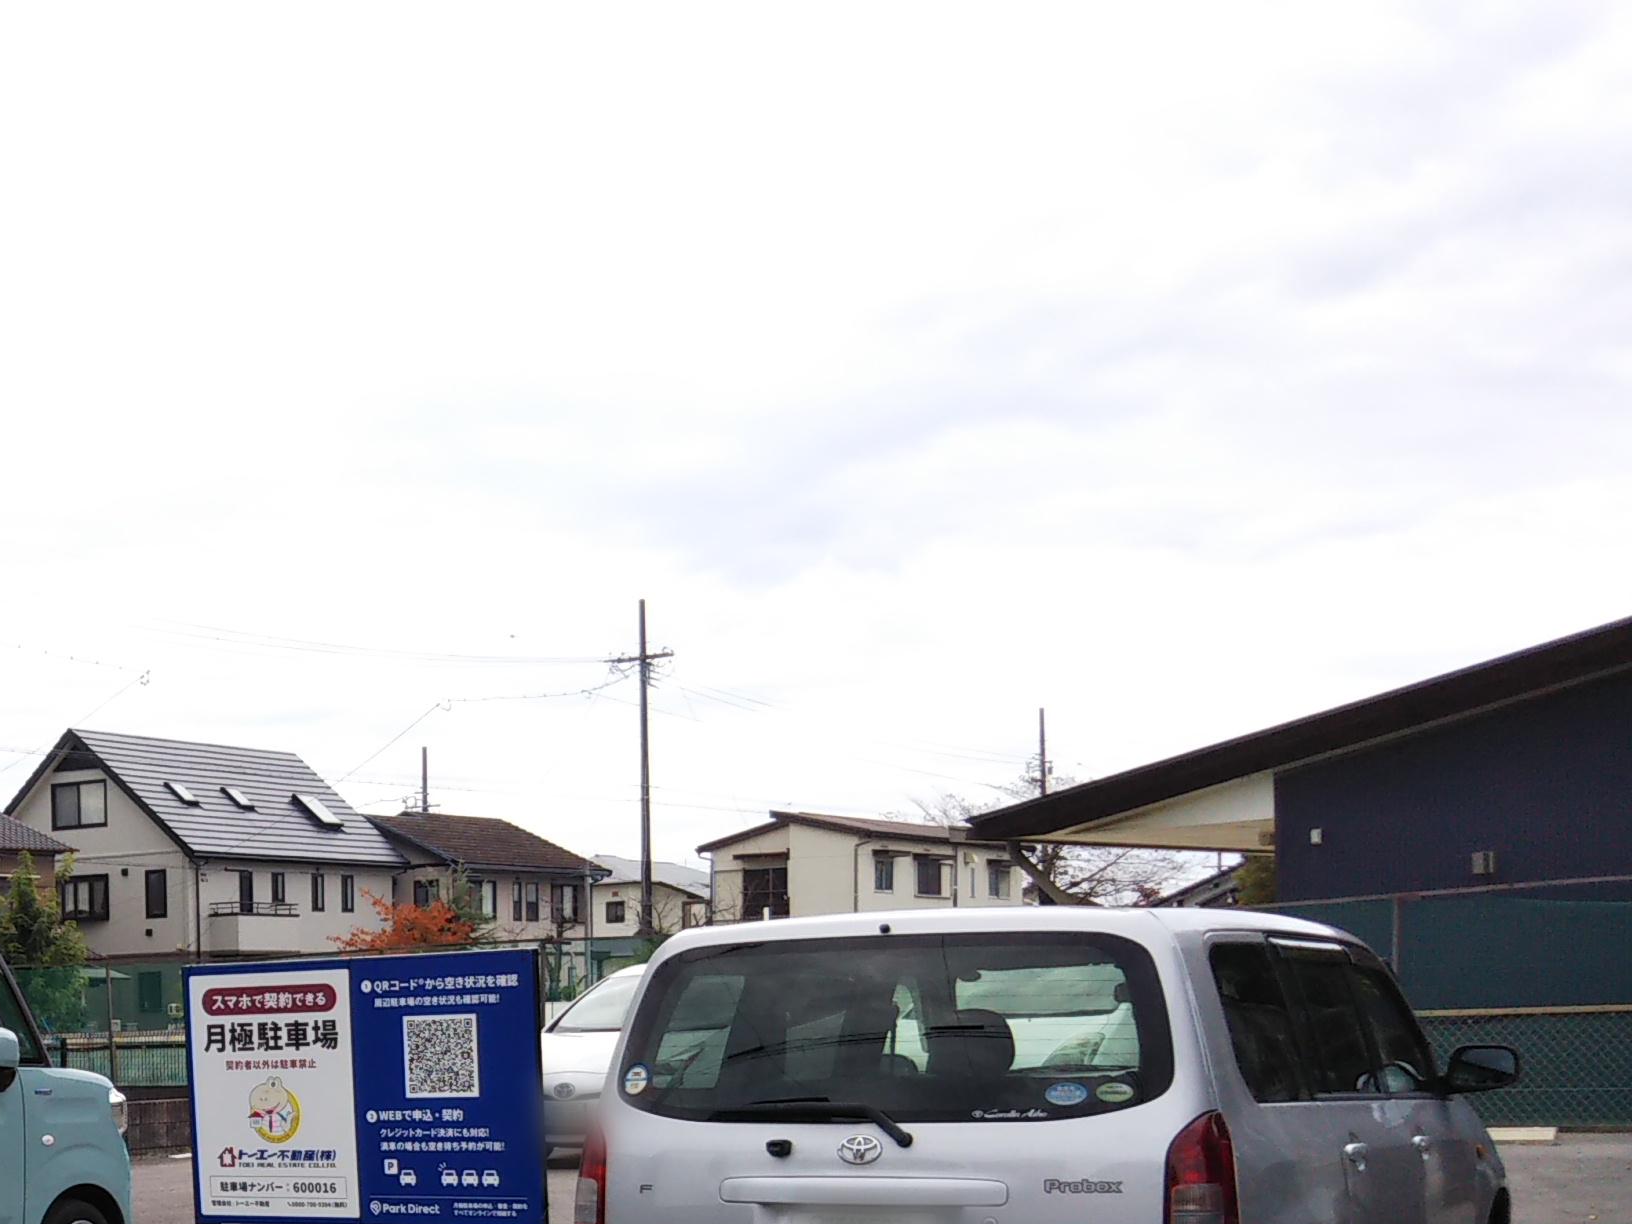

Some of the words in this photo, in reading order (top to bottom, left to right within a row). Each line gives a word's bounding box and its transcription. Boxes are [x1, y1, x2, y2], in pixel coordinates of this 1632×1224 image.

[212, 992, 326, 1010] スマホで契約できる
[204, 1020, 339, 1053] 月極駐車場
[225, 1059, 317, 1071] 契約者以外は駐車禁止
[640, 1184, 653, 1194] F
[1044, 1179, 1123, 1194] Probox
[383, 1203, 406, 1214] Park
[407, 1204, 440, 1214] Direct
